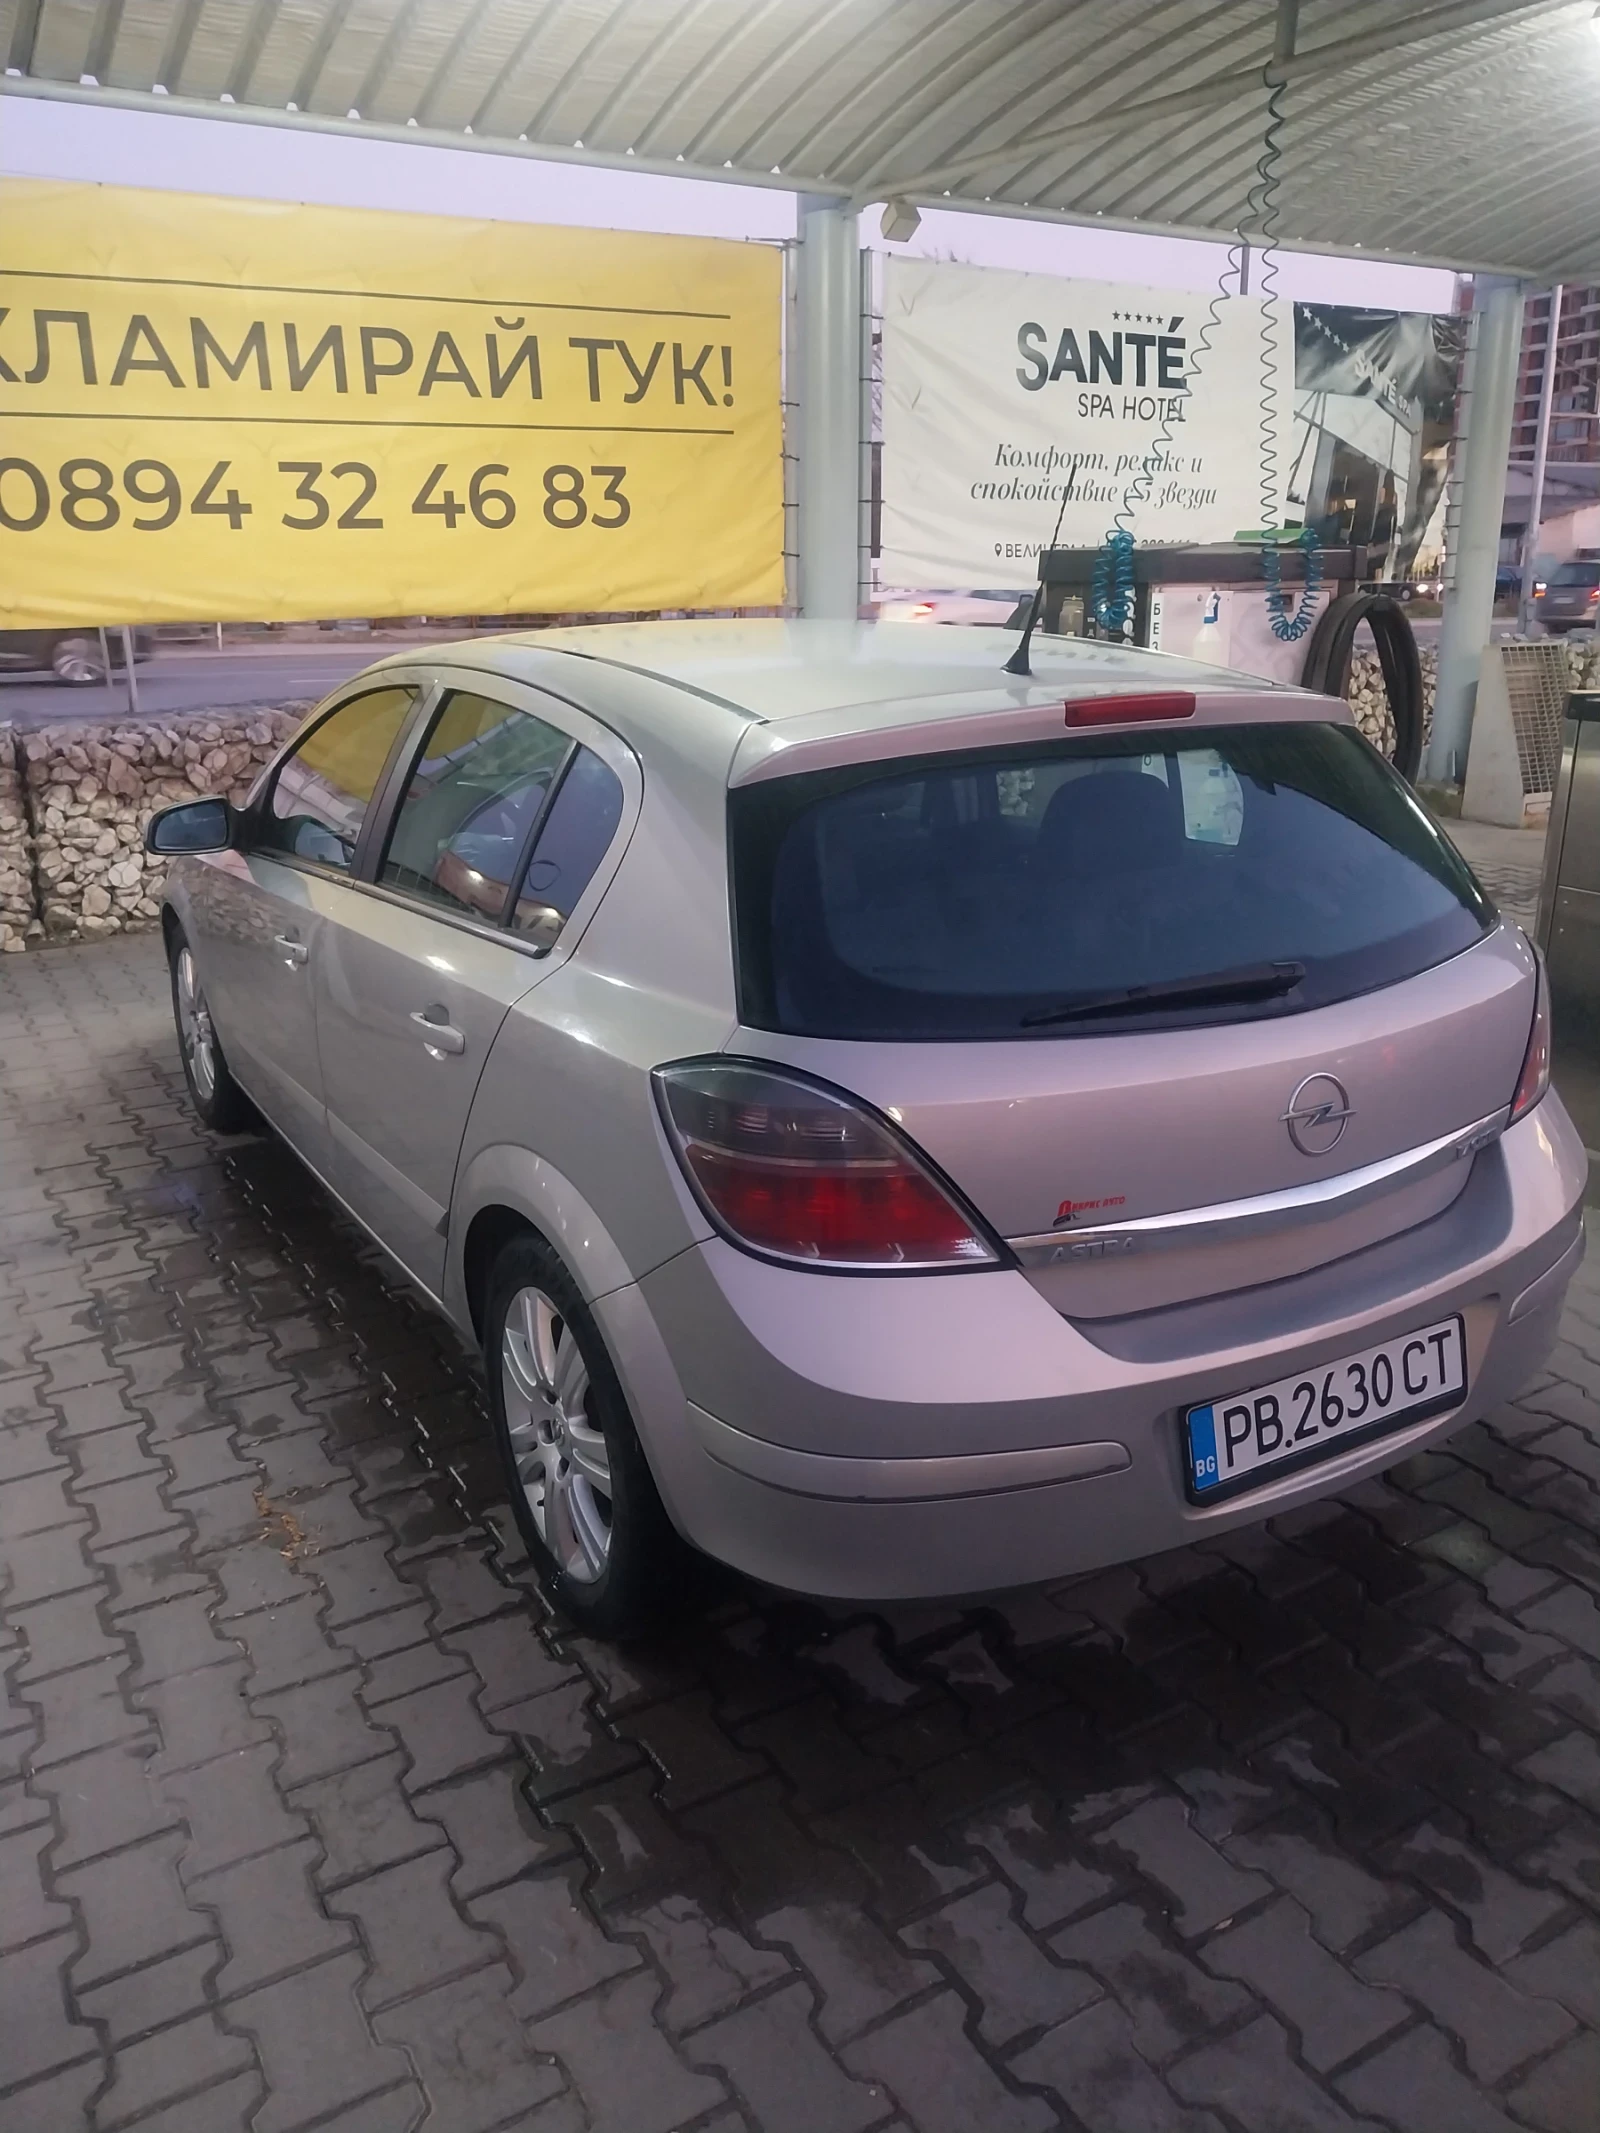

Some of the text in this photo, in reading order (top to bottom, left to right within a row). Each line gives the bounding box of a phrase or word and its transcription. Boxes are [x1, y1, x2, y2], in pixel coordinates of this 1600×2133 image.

[1016, 316, 1187, 391] SANTÉ
[568, 337, 734, 408] ТУК!
[1078, 393, 1187, 422] SPA HOTEL
[994, 443, 1109, 474] Комфорт,
[1190, 457, 1203, 473] и
[0, 457, 631, 532] 0894 32 46 83
[970, 477, 1118, 502] спокойствие
[1153, 480, 1218, 510] звезди
[1195, 1454, 1217, 1478] BG
